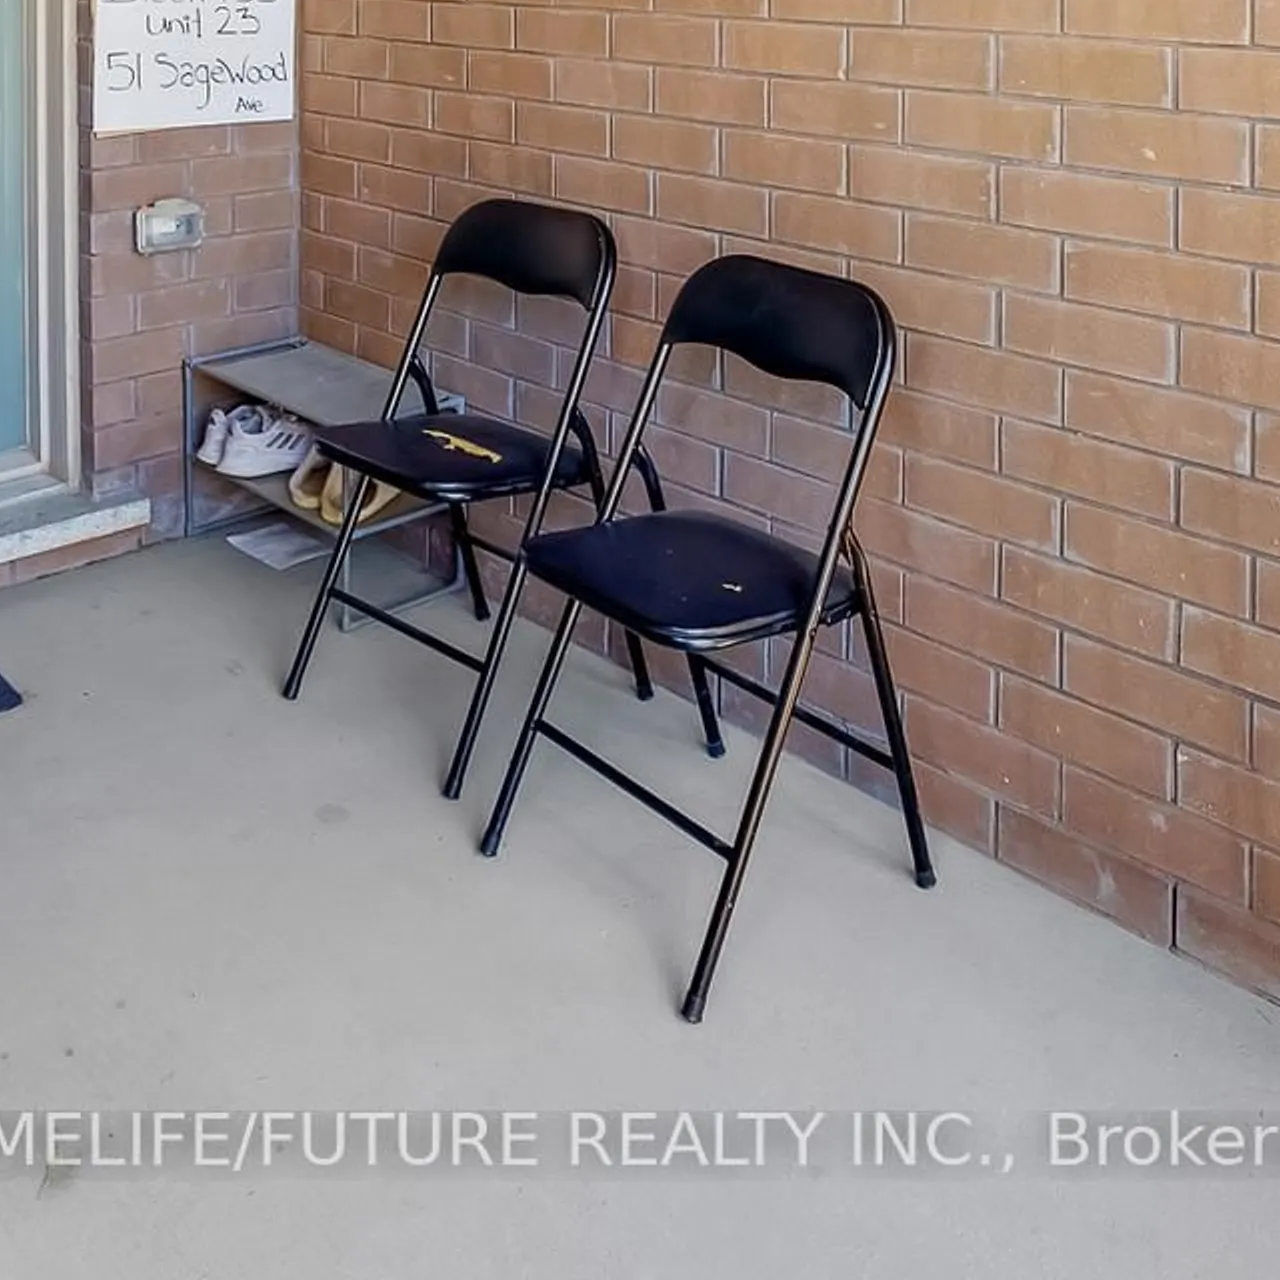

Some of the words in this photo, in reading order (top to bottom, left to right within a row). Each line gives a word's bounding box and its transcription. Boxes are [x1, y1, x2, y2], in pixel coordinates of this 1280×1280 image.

[215, 6, 261, 35] 23
[107, 52, 141, 91] 51
[235, 96, 264, 113] Ave
